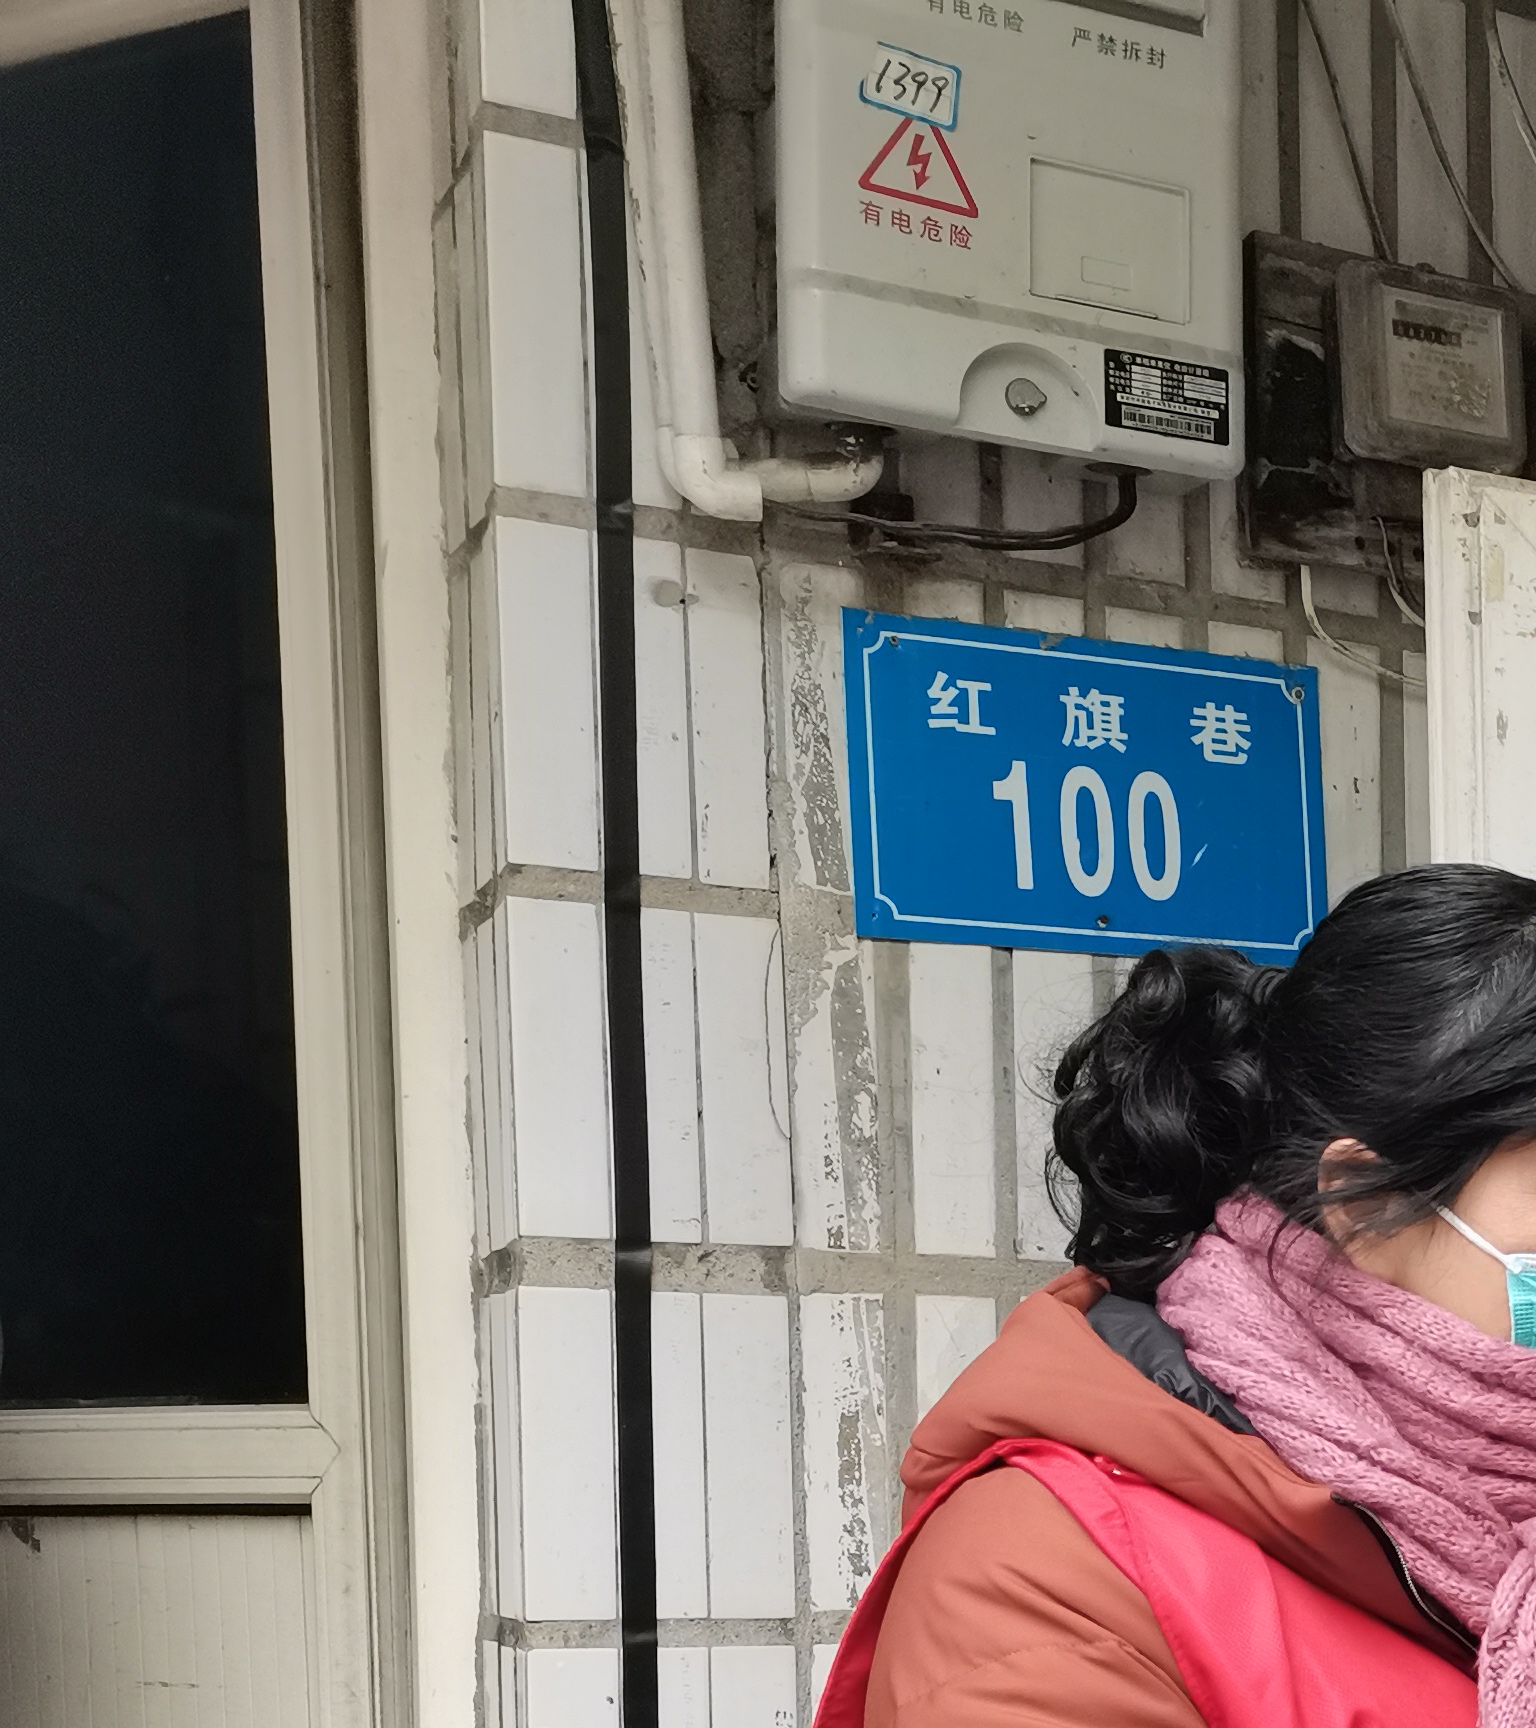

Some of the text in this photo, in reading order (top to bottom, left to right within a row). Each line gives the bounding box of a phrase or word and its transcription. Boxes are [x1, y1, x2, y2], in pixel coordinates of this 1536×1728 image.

[926, 0, 1025, 33] 有电危险
[1071, 26, 1166, 69] 严禁拆封
[876, 59, 950, 113] 1399
[859, 200, 973, 250] 有电危险
[927, 671, 1252, 766] 红旗巷
[992, 760, 1182, 901] 100
